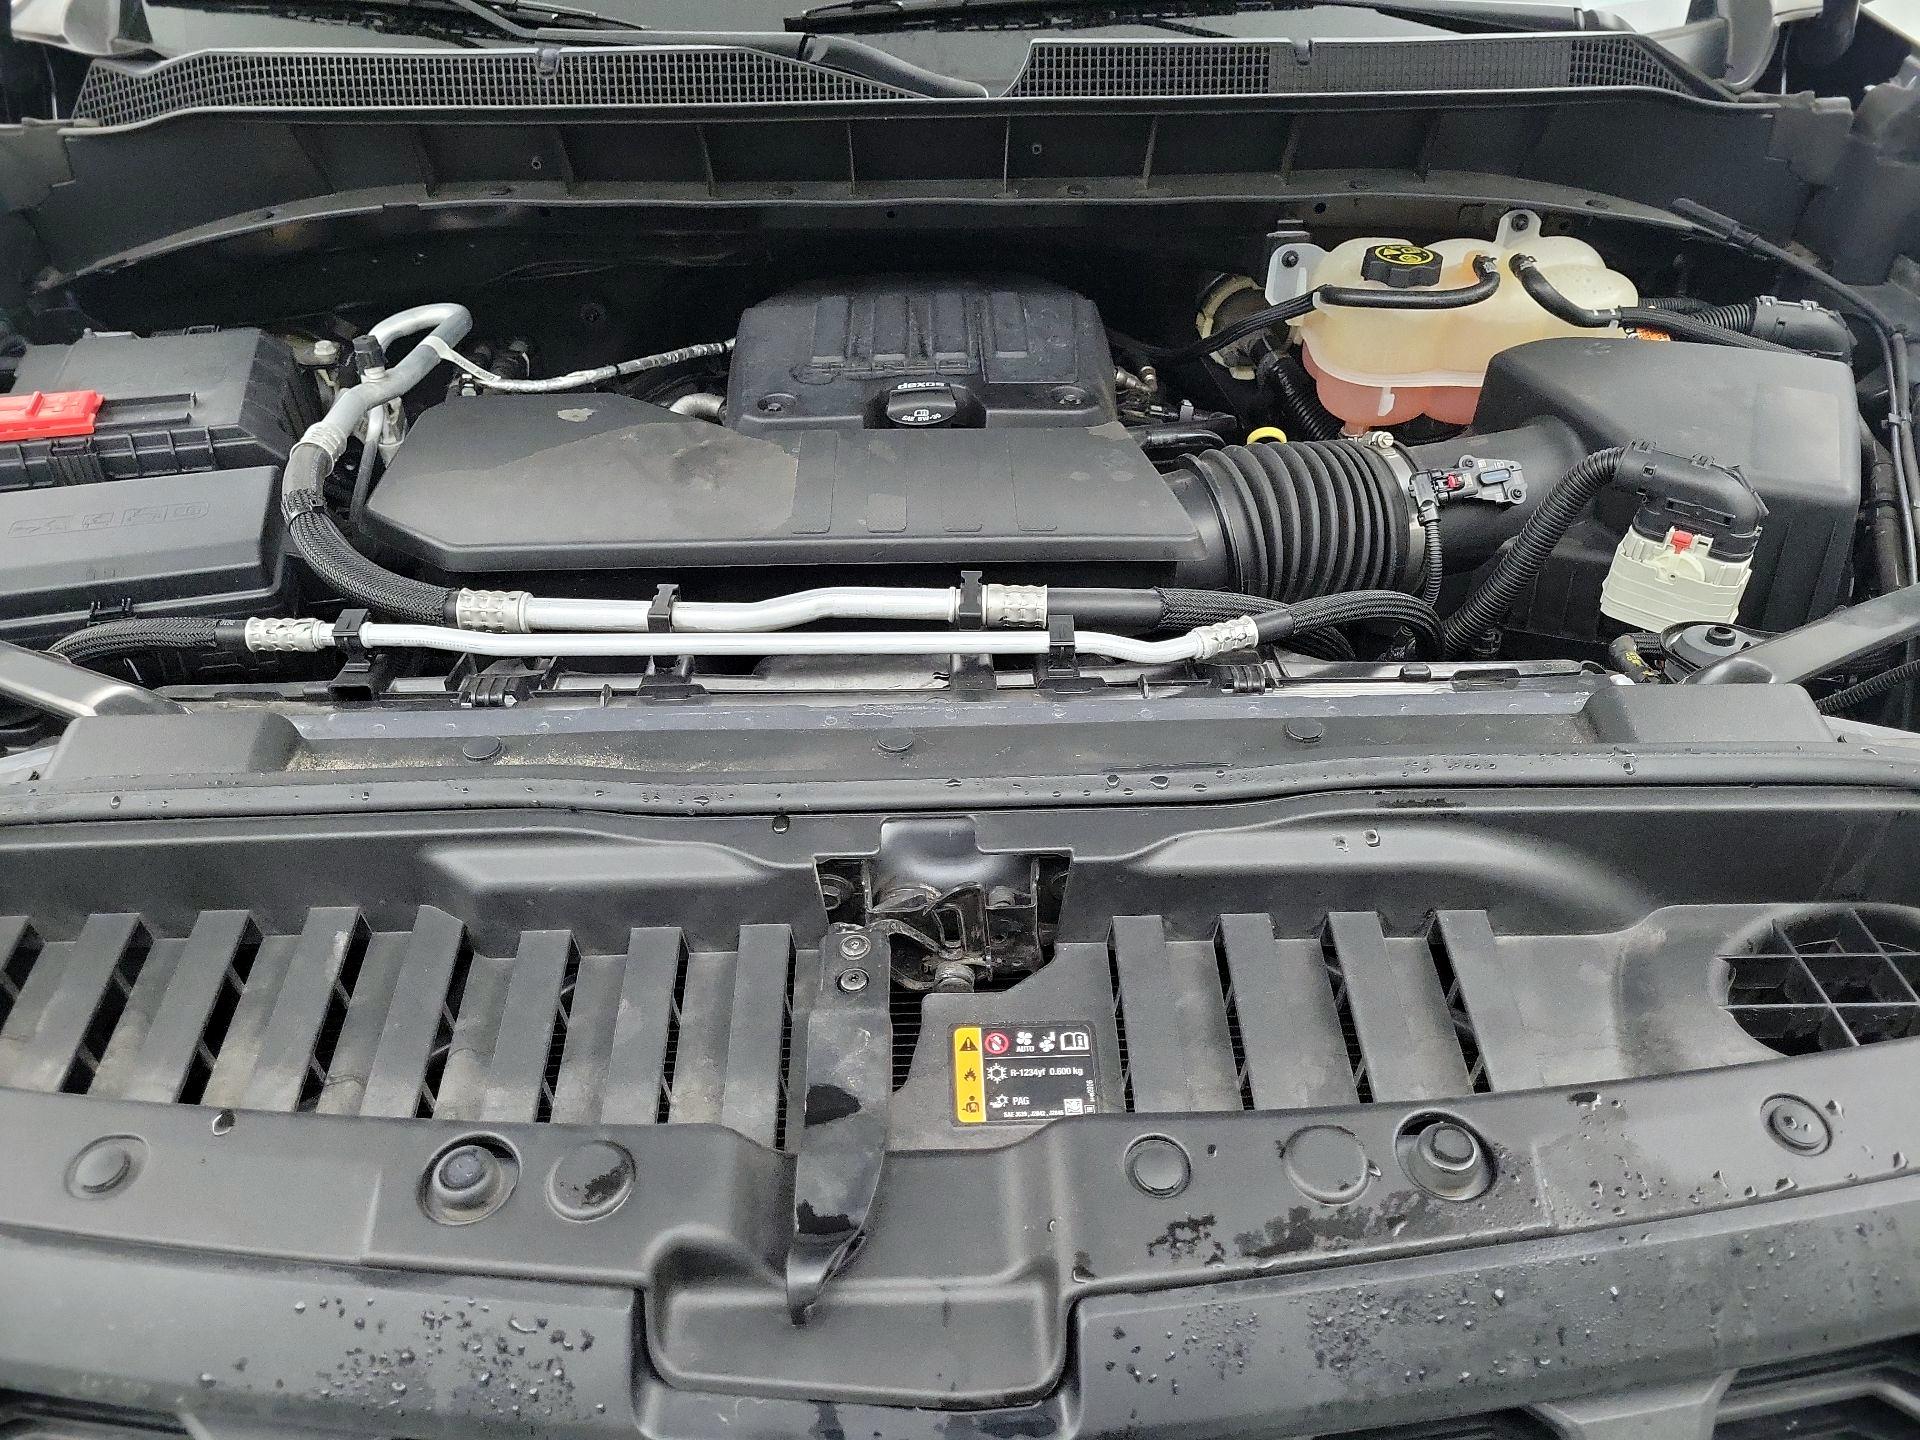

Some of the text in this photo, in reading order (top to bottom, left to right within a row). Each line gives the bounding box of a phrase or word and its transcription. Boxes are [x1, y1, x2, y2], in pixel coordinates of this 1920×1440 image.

[1016, 1045, 1035, 1053] AUTO
[1010, 1067, 1083, 1078] R-1234yf 0.600 kg
[1012, 1096, 1030, 1106] PAG
